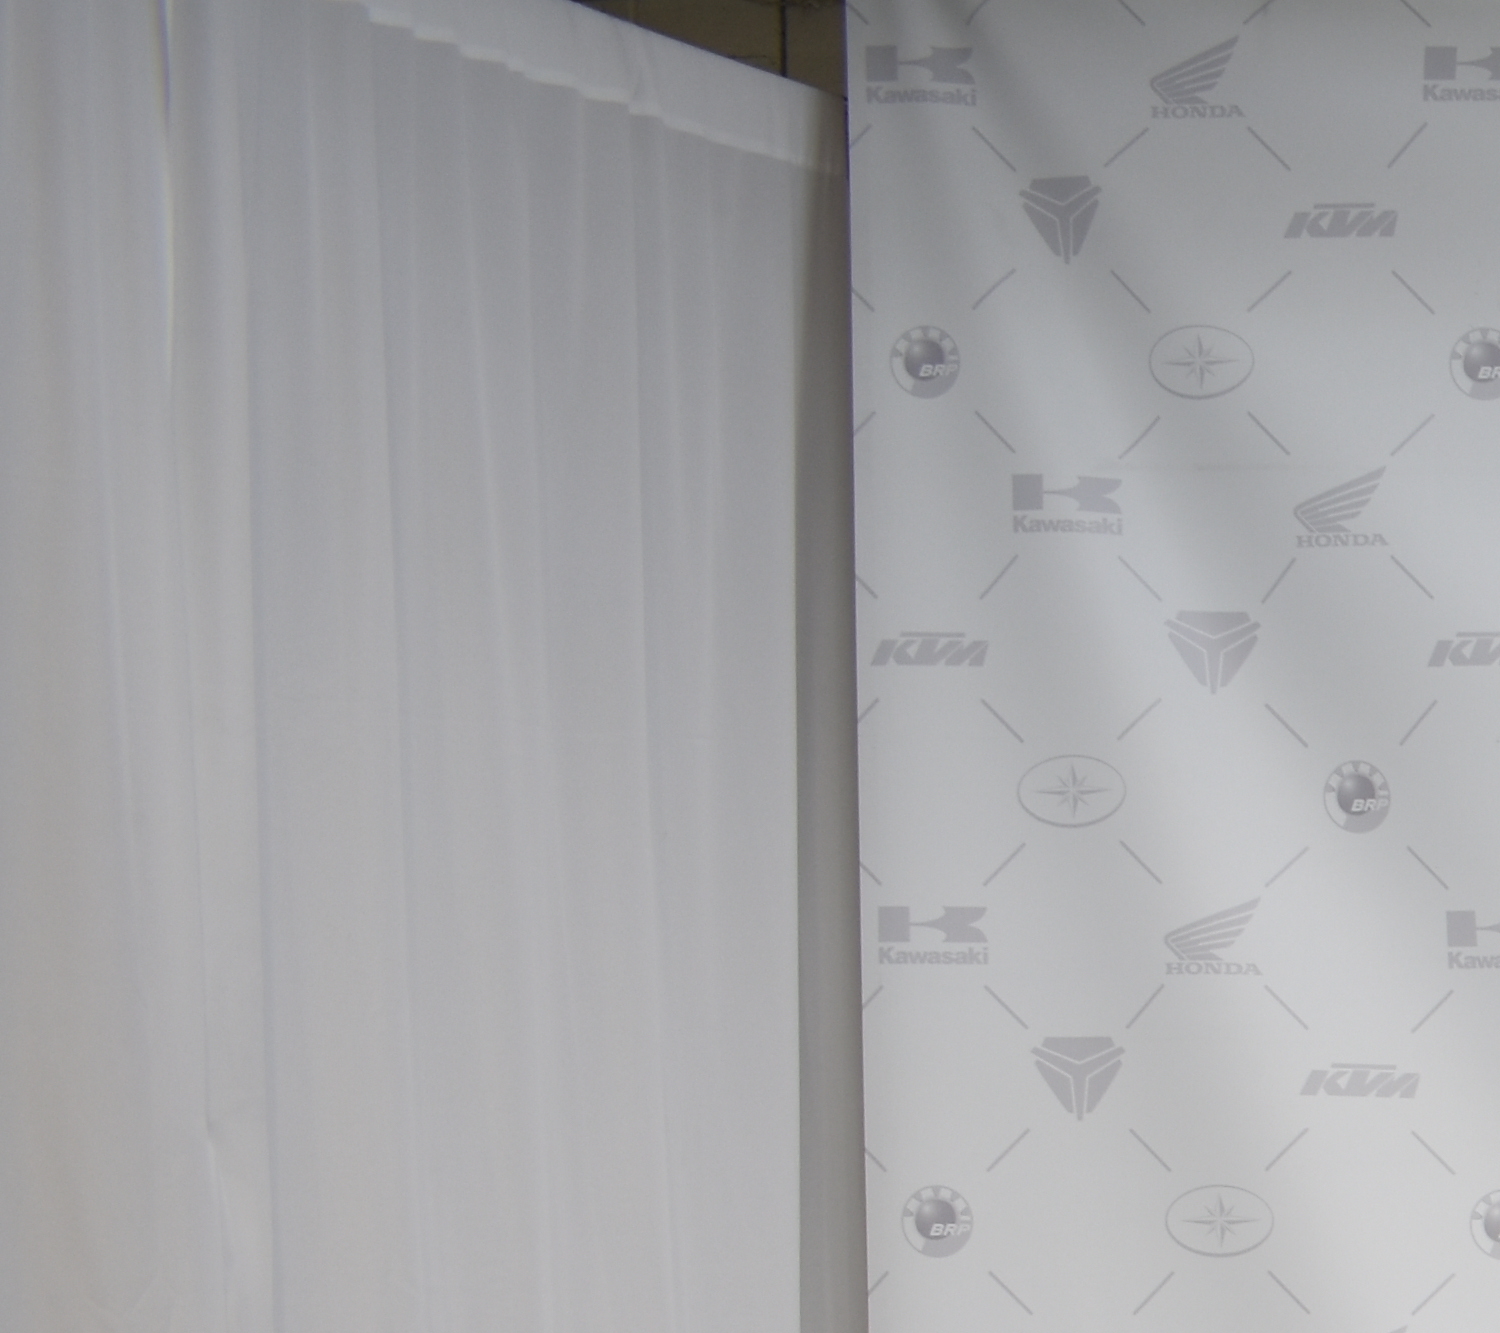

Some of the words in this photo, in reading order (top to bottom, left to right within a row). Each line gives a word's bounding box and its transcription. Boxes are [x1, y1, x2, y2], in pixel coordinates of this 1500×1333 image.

[1151, 102, 1244, 119] HONDA
[1284, 203, 1397, 238] KTM
[920, 362, 957, 376] BRP
[1013, 514, 1122, 537] Kawasaki
[1293, 532, 1388, 548] HONDA
[868, 628, 991, 668] KTM
[878, 944, 986, 966] Kawasaki
[1164, 961, 1262, 976] HONDA
[1300, 1063, 1419, 1098] KTM
[931, 1222, 968, 1236] BRP
